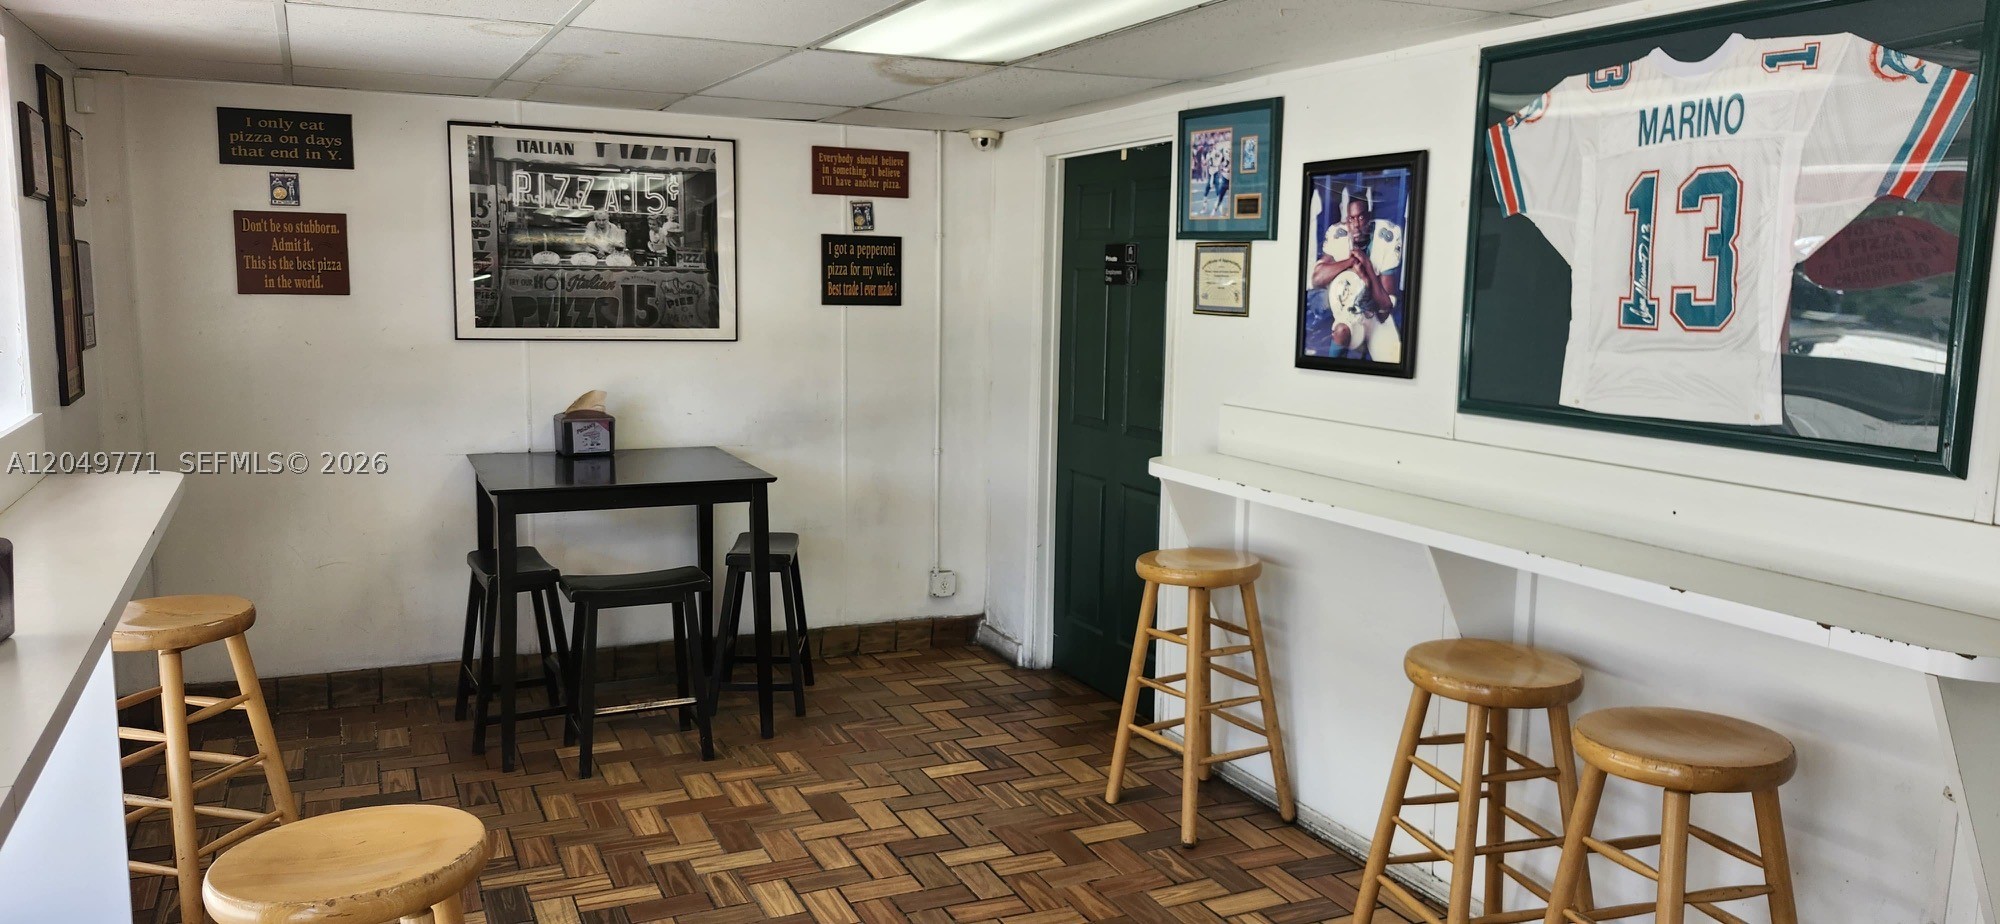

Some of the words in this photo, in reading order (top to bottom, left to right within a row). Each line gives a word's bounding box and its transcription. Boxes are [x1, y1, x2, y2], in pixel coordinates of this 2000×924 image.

[246, 117, 252, 127] I
[258, 118, 294, 132] only
[300, 121, 325, 131] eat
[1638, 93, 1746, 147] MARINO
[230, 131, 273, 144] pizza
[279, 134, 299, 144] on
[305, 134, 343, 148] days
[516, 139, 575, 156] ITALIAN
[231, 145, 265, 158] that
[271, 147, 299, 159] end
[305, 148, 322, 160] in
[328, 150, 343, 161] Y.
[818, 152, 854, 168] Everybody
[856, 154, 878, 166] should
[881, 156, 904, 167] believe
[822, 165, 830, 176] in
[832, 166, 869, 179] something.
[878, 167, 901, 178] believe
[821, 176, 832, 186] I'll
[835, 177, 852, 187] have
[854, 178, 880, 188] another
[883, 179, 902, 191] pizza.
[241, 217, 269, 232] Don't
[270, 218, 281, 232] be
[283, 222, 293, 233] so
[295, 219, 340, 235] stubborn.
[271, 237, 302, 252] Admit
[303, 239, 314, 252] it.
[828, 242, 832, 255] I
[834, 244, 848, 259] got
[849, 245, 855, 255] a
[857, 243, 896, 259] pepperoni
[1617, 164, 1744, 333] 13
[243, 255, 267, 270] This
[268, 256, 277, 270] is
[279, 256, 294, 270] the
[295, 257, 316, 271] best
[317, 258, 342, 273] pizza
[827, 263, 848, 279] pizza
[850, 262, 861, 276] for
[862, 265, 874, 279] my
[876, 263, 896, 276] wife.
[264, 275, 276, 288] in
[277, 275, 292, 288] the
[294, 275, 324, 289] world.
[828, 282, 842, 296] Best
[843, 281, 860, 296] trade
[864, 285, 877, 296] ever
